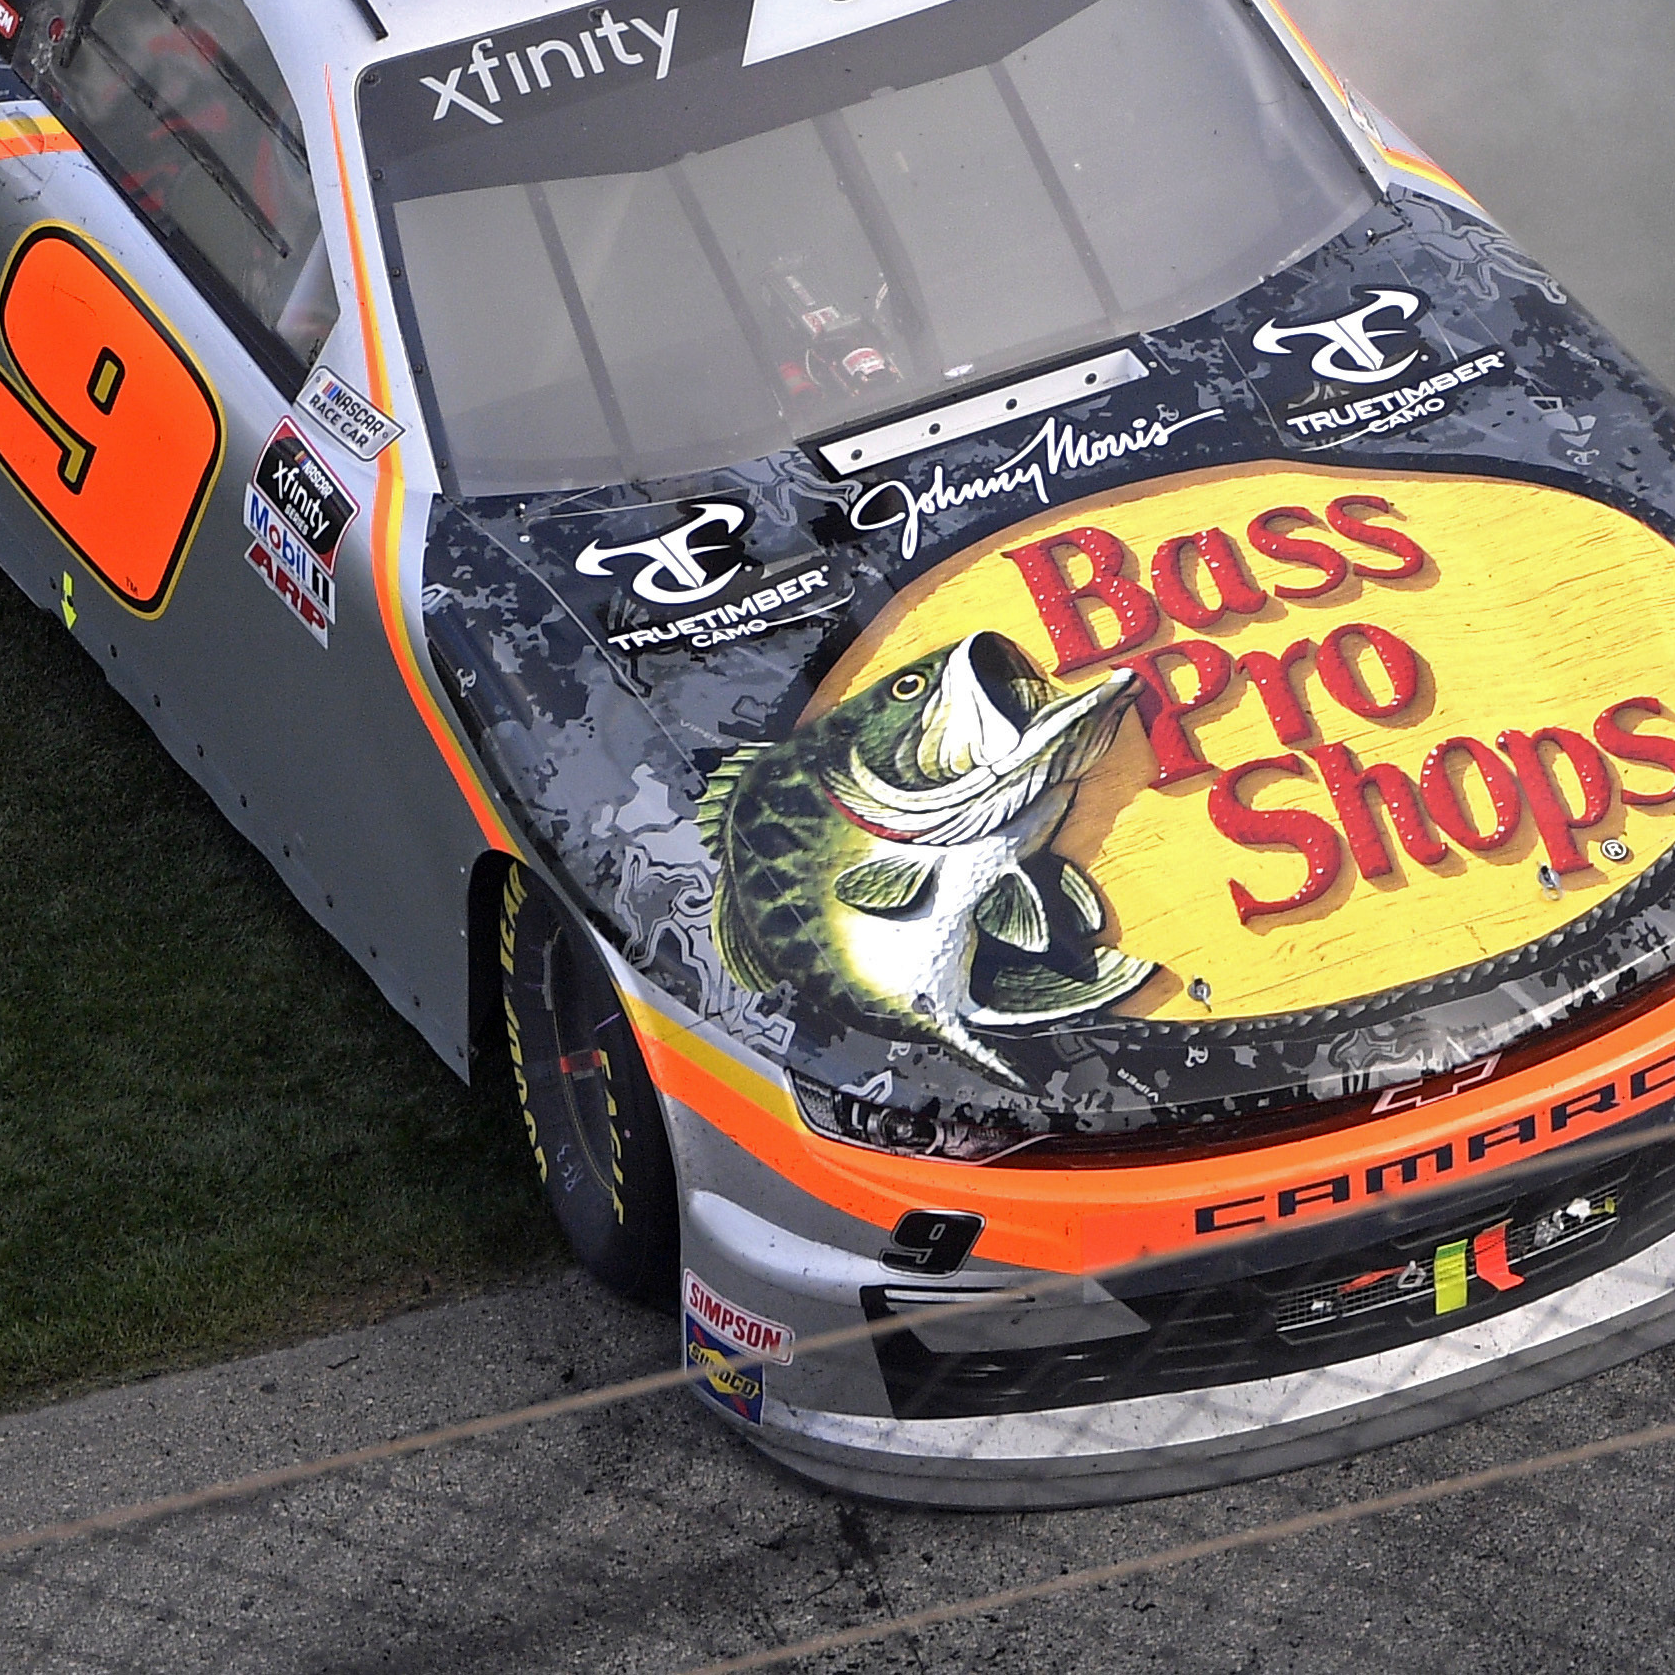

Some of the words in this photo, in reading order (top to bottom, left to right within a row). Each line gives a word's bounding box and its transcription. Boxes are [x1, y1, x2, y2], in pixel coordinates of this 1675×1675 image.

[418, 8, 682, 125] xfinity
[308, 394, 341, 426] RACE
[340, 421, 370, 449] CAR
[329, 385, 386, 438] NASCAR
[1287, 353, 1502, 436] TRUETIMBER
[1366, 396, 1446, 435] CAMO
[271, 459, 331, 540] xfinity
[302, 459, 334, 500] NASCAR
[849, 463, 1050, 560] Johnny
[995, 408, 1225, 476] Morris
[249, 492, 308, 581] Mobil
[284, 502, 310, 537] SERIES
[247, 543, 327, 631] ARP
[607, 568, 825, 654] TRUETIMBER
[1000, 493, 1427, 678] Bass
[690, 616, 770, 648] CAMO
[1102, 621, 1421, 792] Pro
[1115, 1067, 1160, 1104] VIPER
[878, 1208, 987, 1277] 9
[689, 1281, 783, 1356] SIMPSON
[689, 1343, 759, 1398] SUOCO
